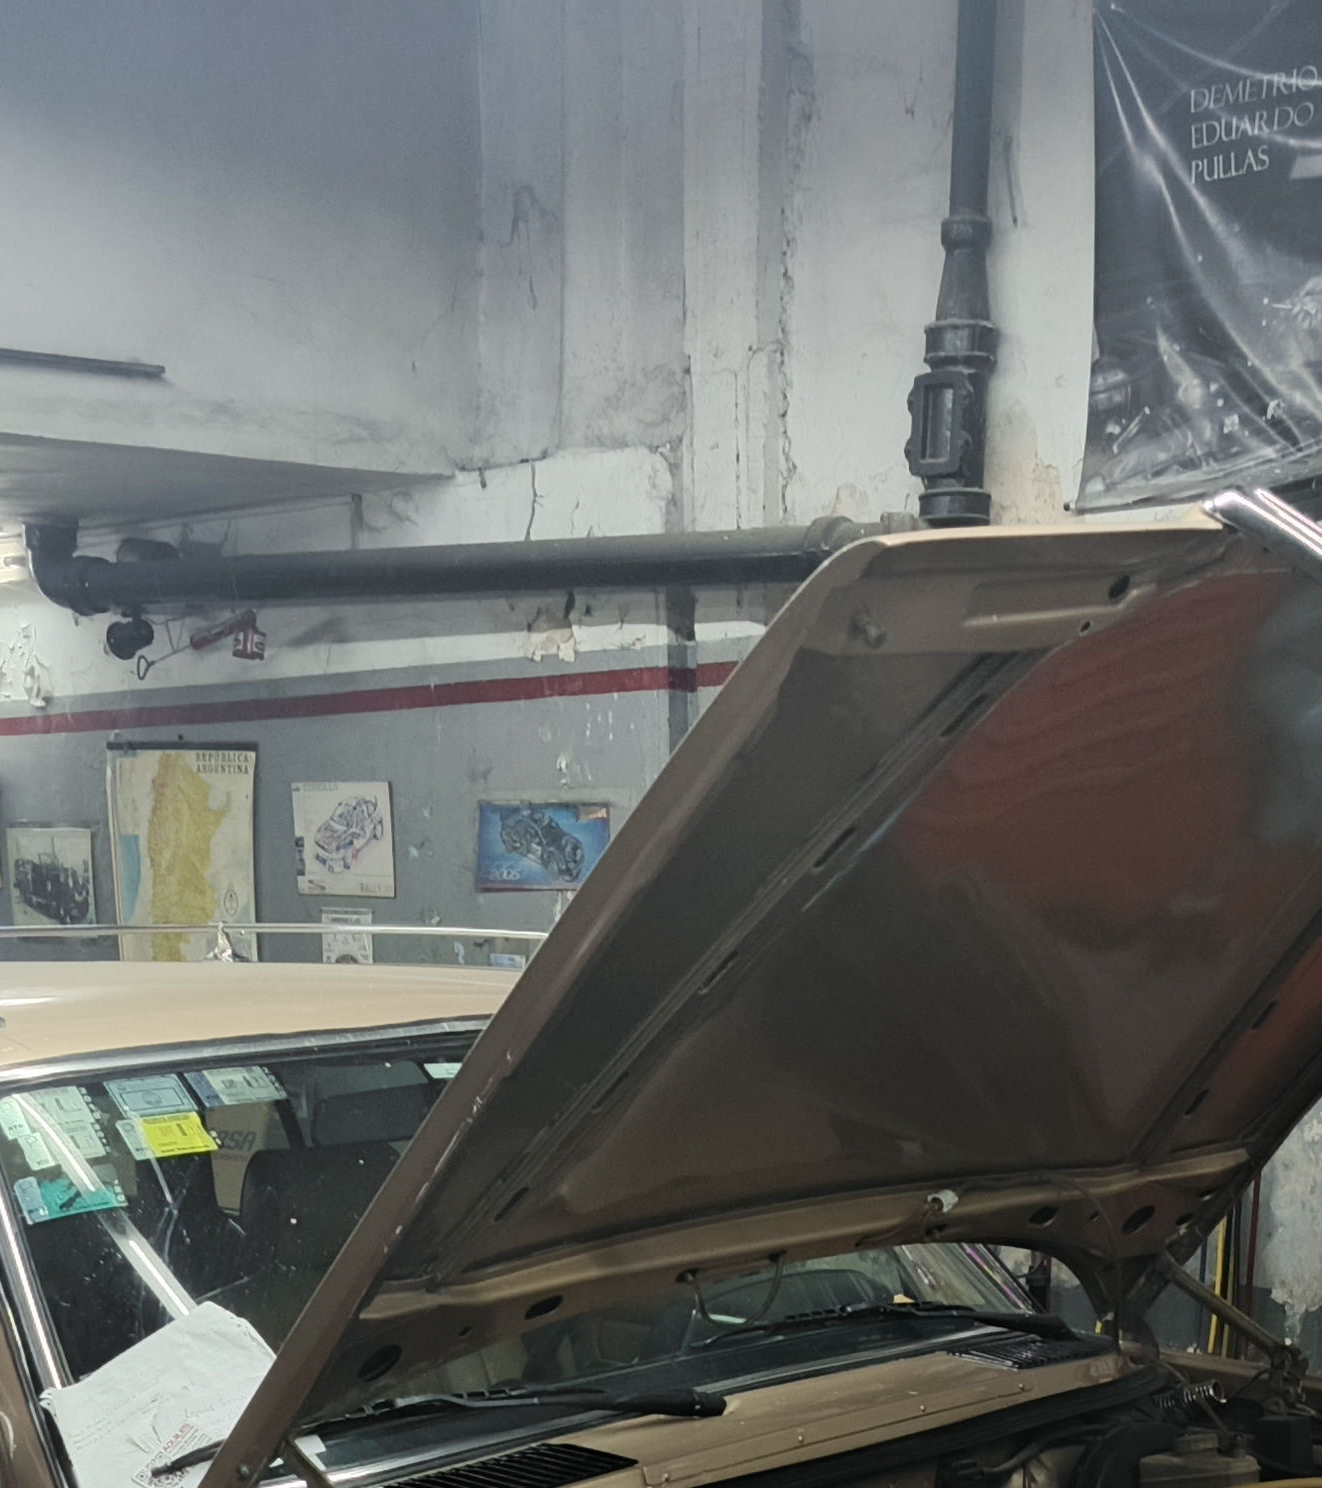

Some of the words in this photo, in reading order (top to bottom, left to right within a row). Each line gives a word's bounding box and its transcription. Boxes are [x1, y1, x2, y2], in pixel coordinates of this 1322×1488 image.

[1190, 65, 1319, 113] DEMETRIO
[1191, 101, 1315, 149] EDUARDO
[1191, 145, 1270, 185] PULLAS
[195, 764, 250, 775] ARGENTINA
